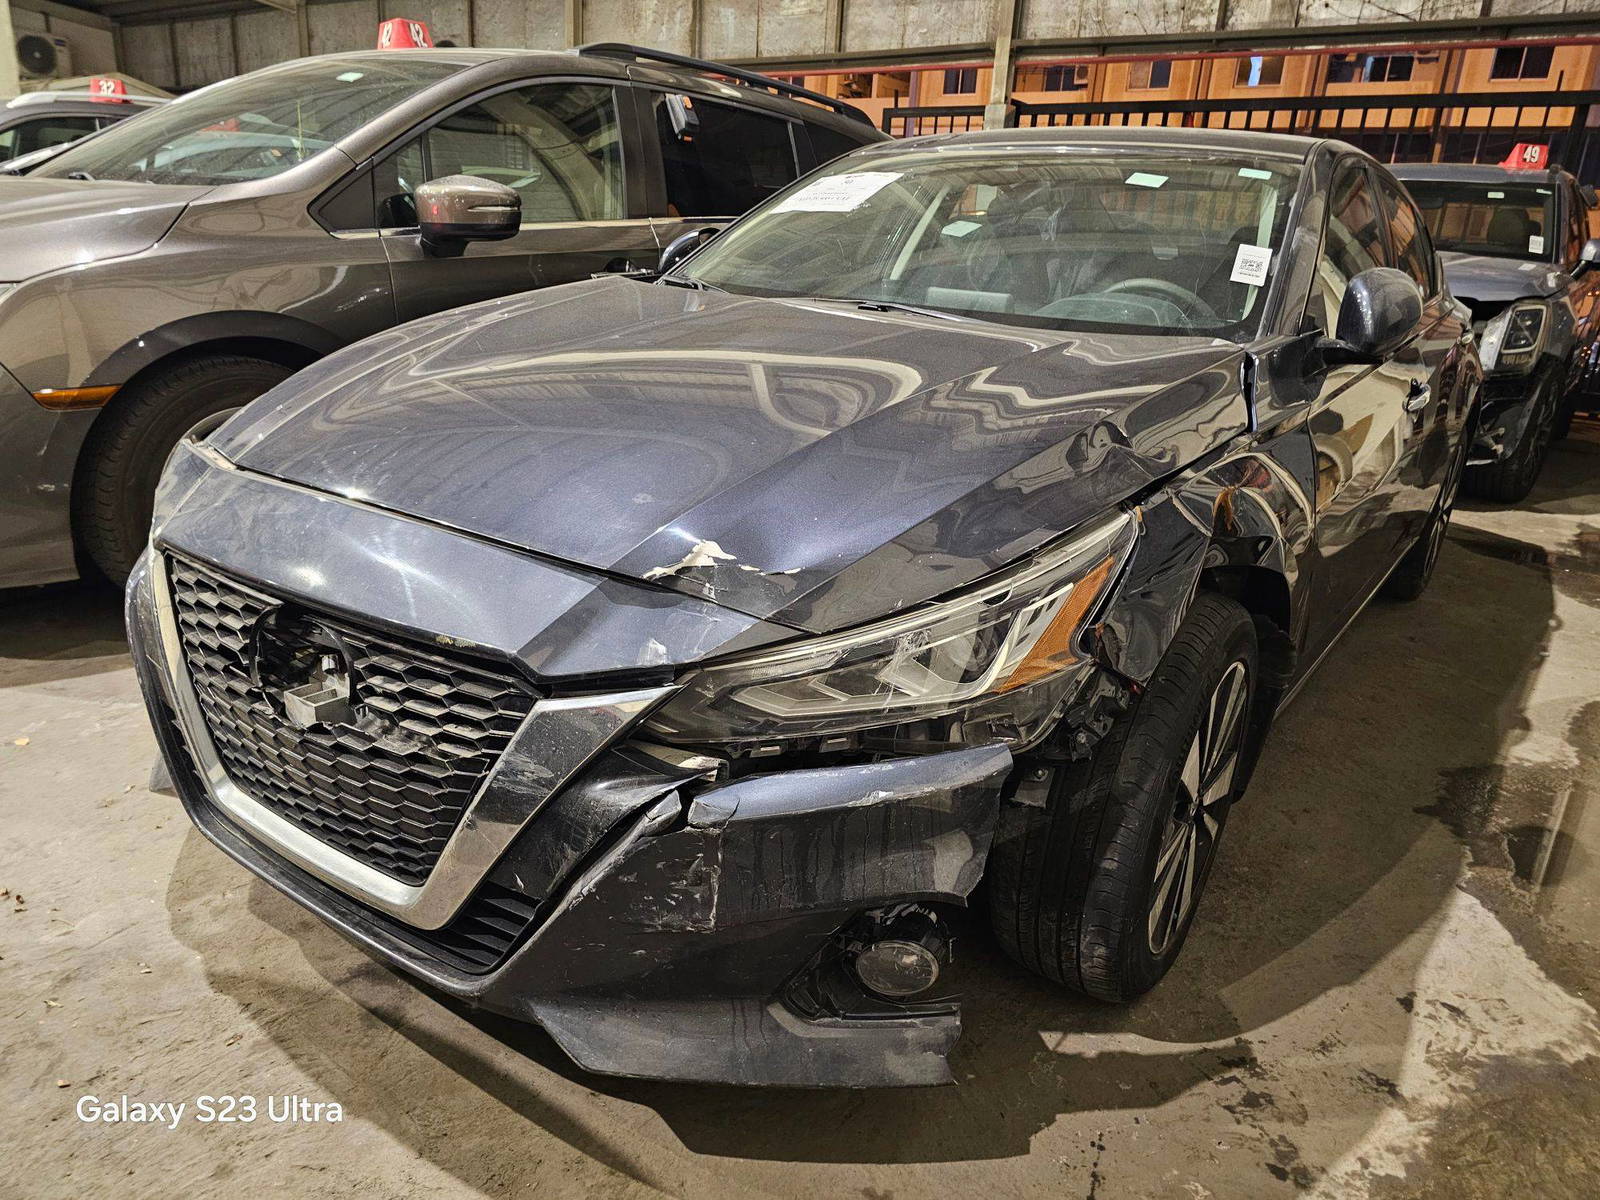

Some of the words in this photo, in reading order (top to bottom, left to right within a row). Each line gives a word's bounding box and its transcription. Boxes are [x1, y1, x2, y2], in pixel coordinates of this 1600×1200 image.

[409, 23, 428, 48] 42
[98, 79, 115, 95] 32
[1523, 145, 1540, 163] 49
